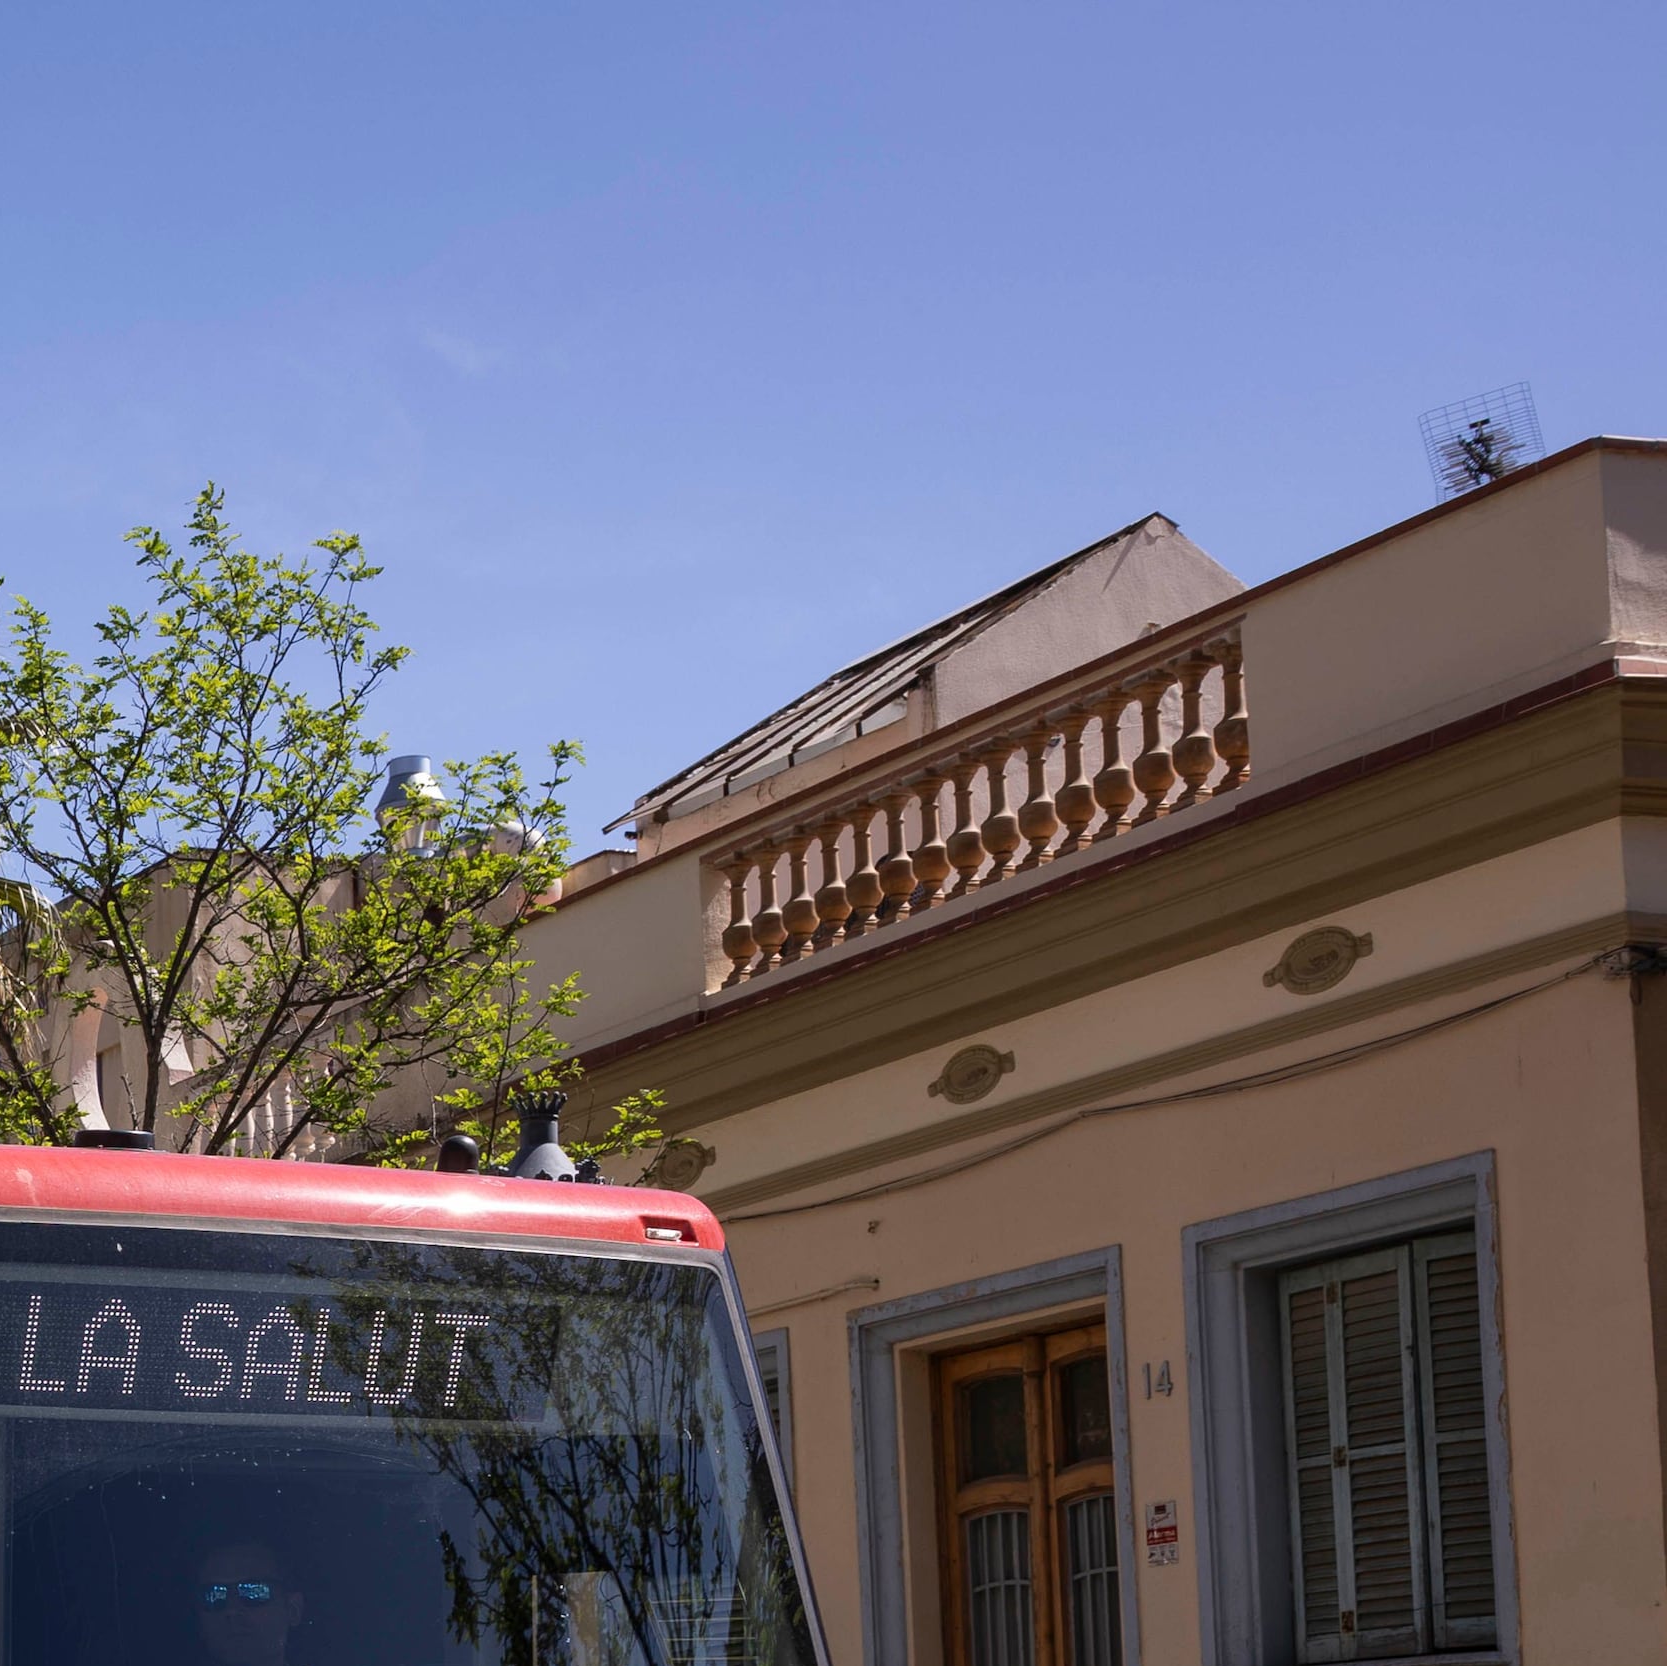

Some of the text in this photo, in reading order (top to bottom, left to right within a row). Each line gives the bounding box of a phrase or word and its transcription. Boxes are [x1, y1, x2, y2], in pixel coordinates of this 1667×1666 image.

[19, 1294, 141, 1396] LA
[174, 1302, 491, 1407] SALUT
[1142, 1359, 1175, 1400] 14
